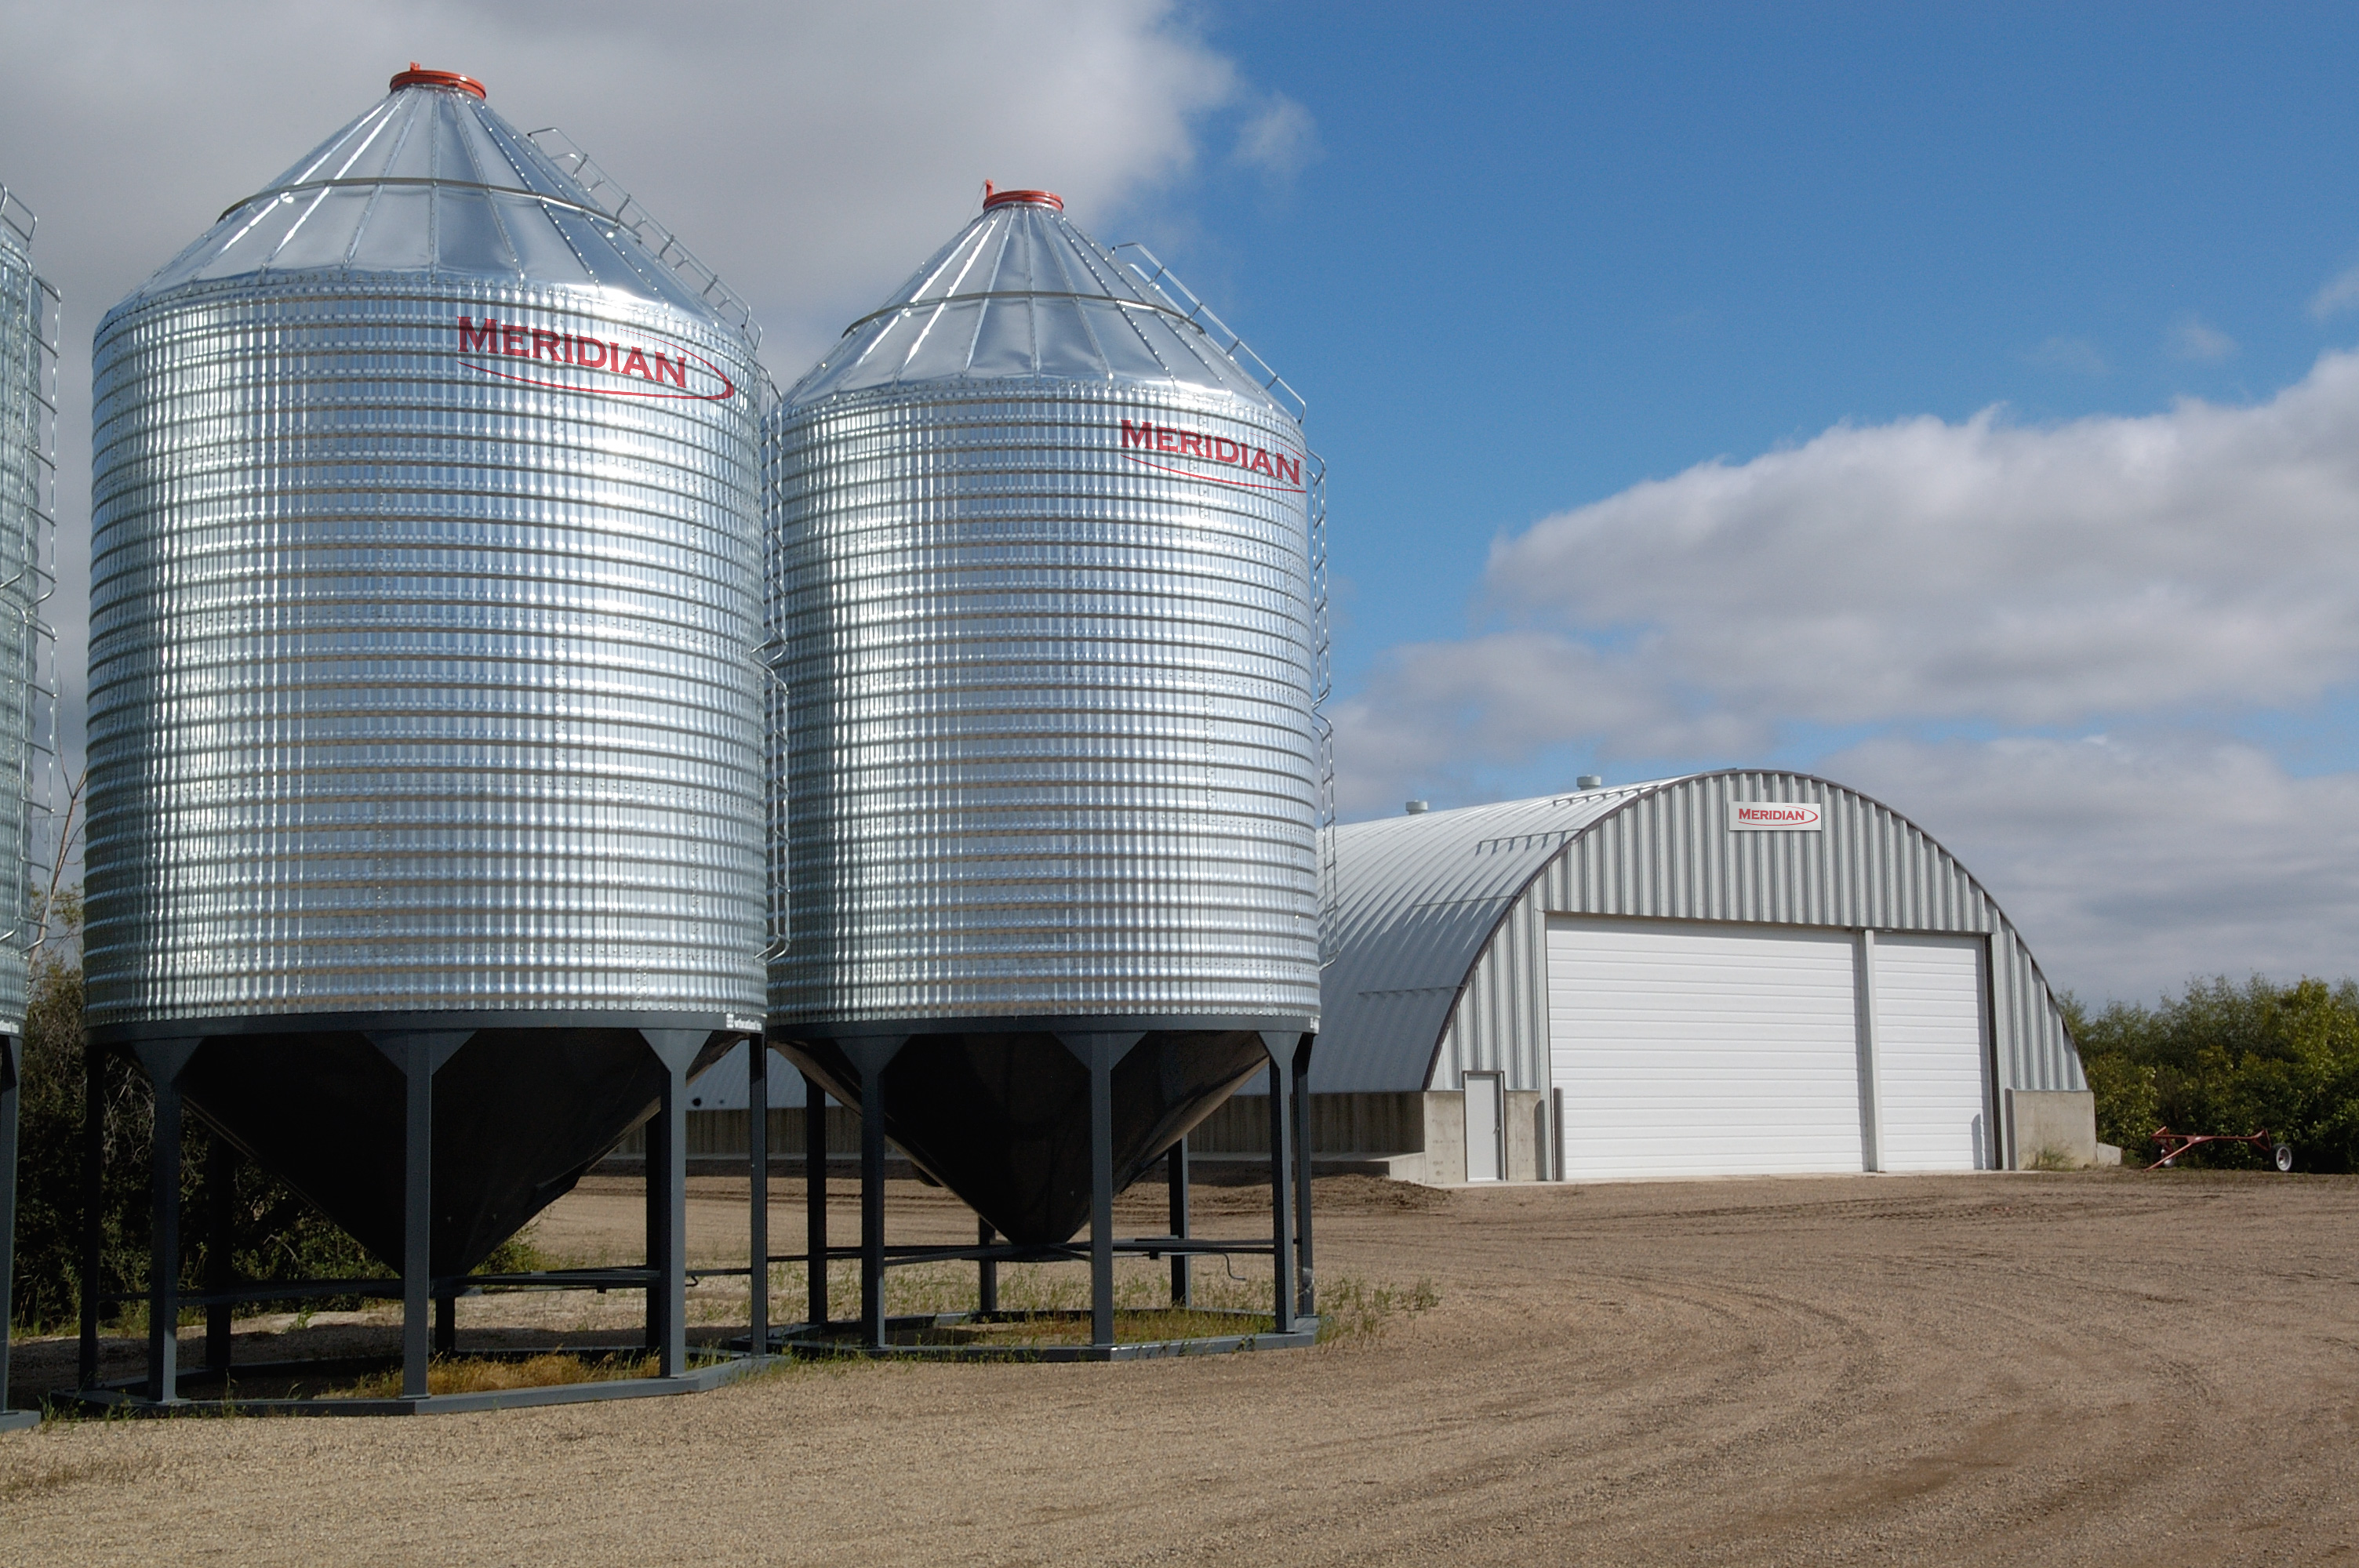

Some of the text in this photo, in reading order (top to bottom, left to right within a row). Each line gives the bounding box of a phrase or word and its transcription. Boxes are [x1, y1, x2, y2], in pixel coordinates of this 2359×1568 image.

[457, 316, 687, 389] MERIDIAN
[1121, 419, 1300, 485] MERIDIAN
[1738, 808, 1805, 821] MERIDIAN
